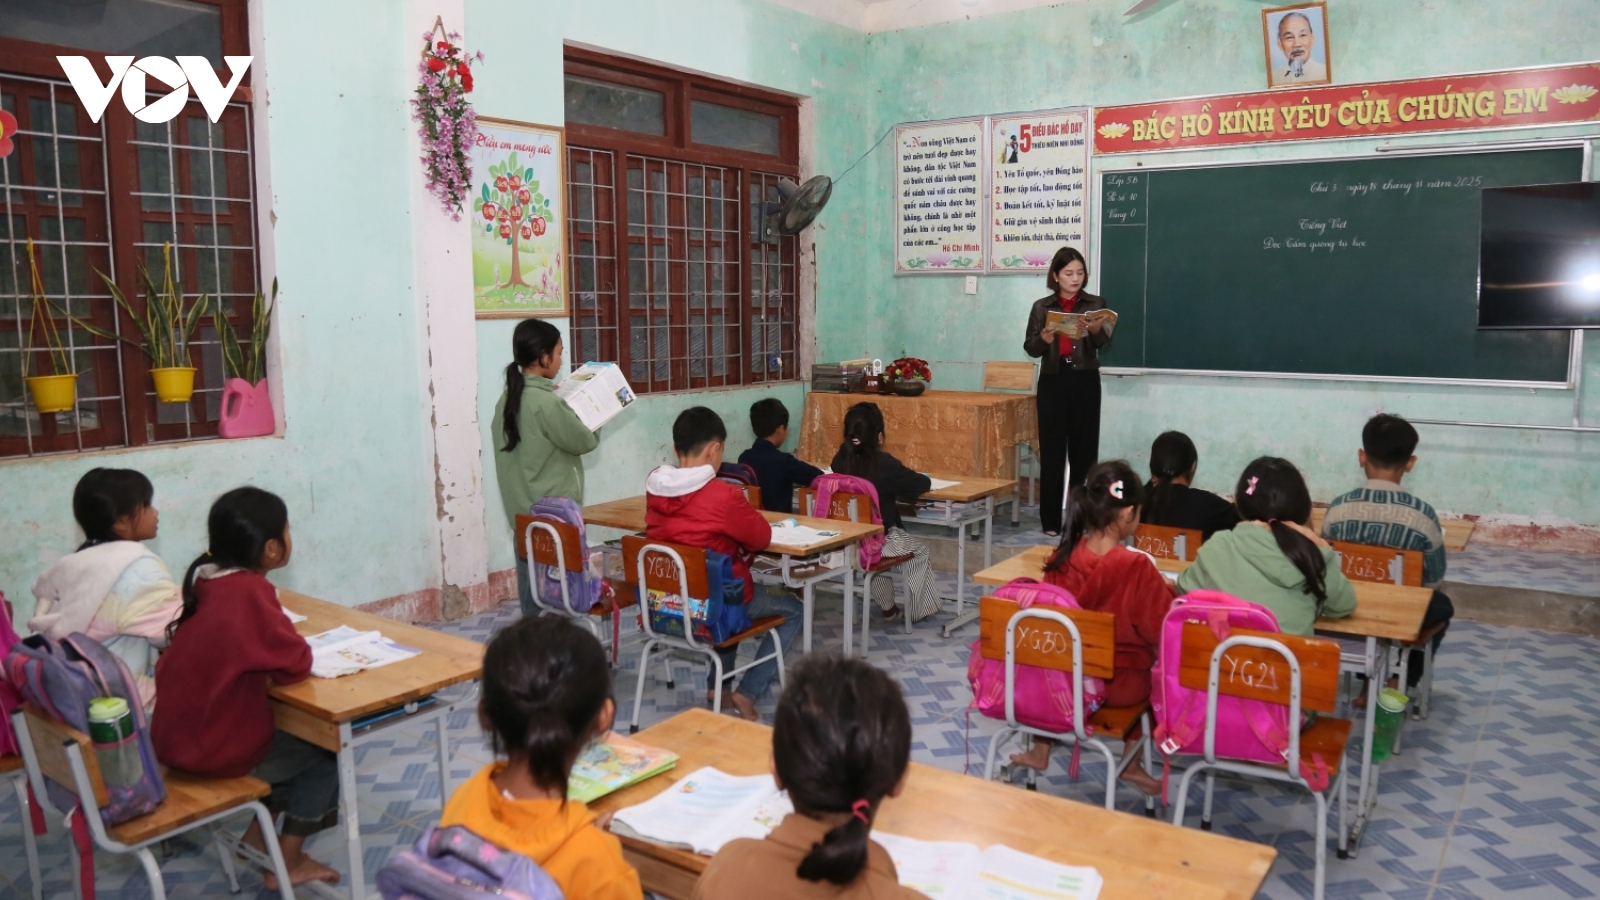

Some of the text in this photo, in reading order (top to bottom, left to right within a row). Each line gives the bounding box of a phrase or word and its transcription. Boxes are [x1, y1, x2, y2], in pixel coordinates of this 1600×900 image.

[1132, 84, 1549, 142] BÁC HỒ KÍNH YÊU CỦA CHÚNG EM
[1019, 123, 1031, 153] 5
[1047, 122, 1060, 136] BÁC
[1070, 122, 1083, 136] DẠY
[996, 171, 1002, 179] 1.
[1453, 175, 1483, 187] 2025
[995, 186, 1002, 194] 2.
[996, 202, 1002, 210] 3.
[963, 243, 980, 252] Minh
